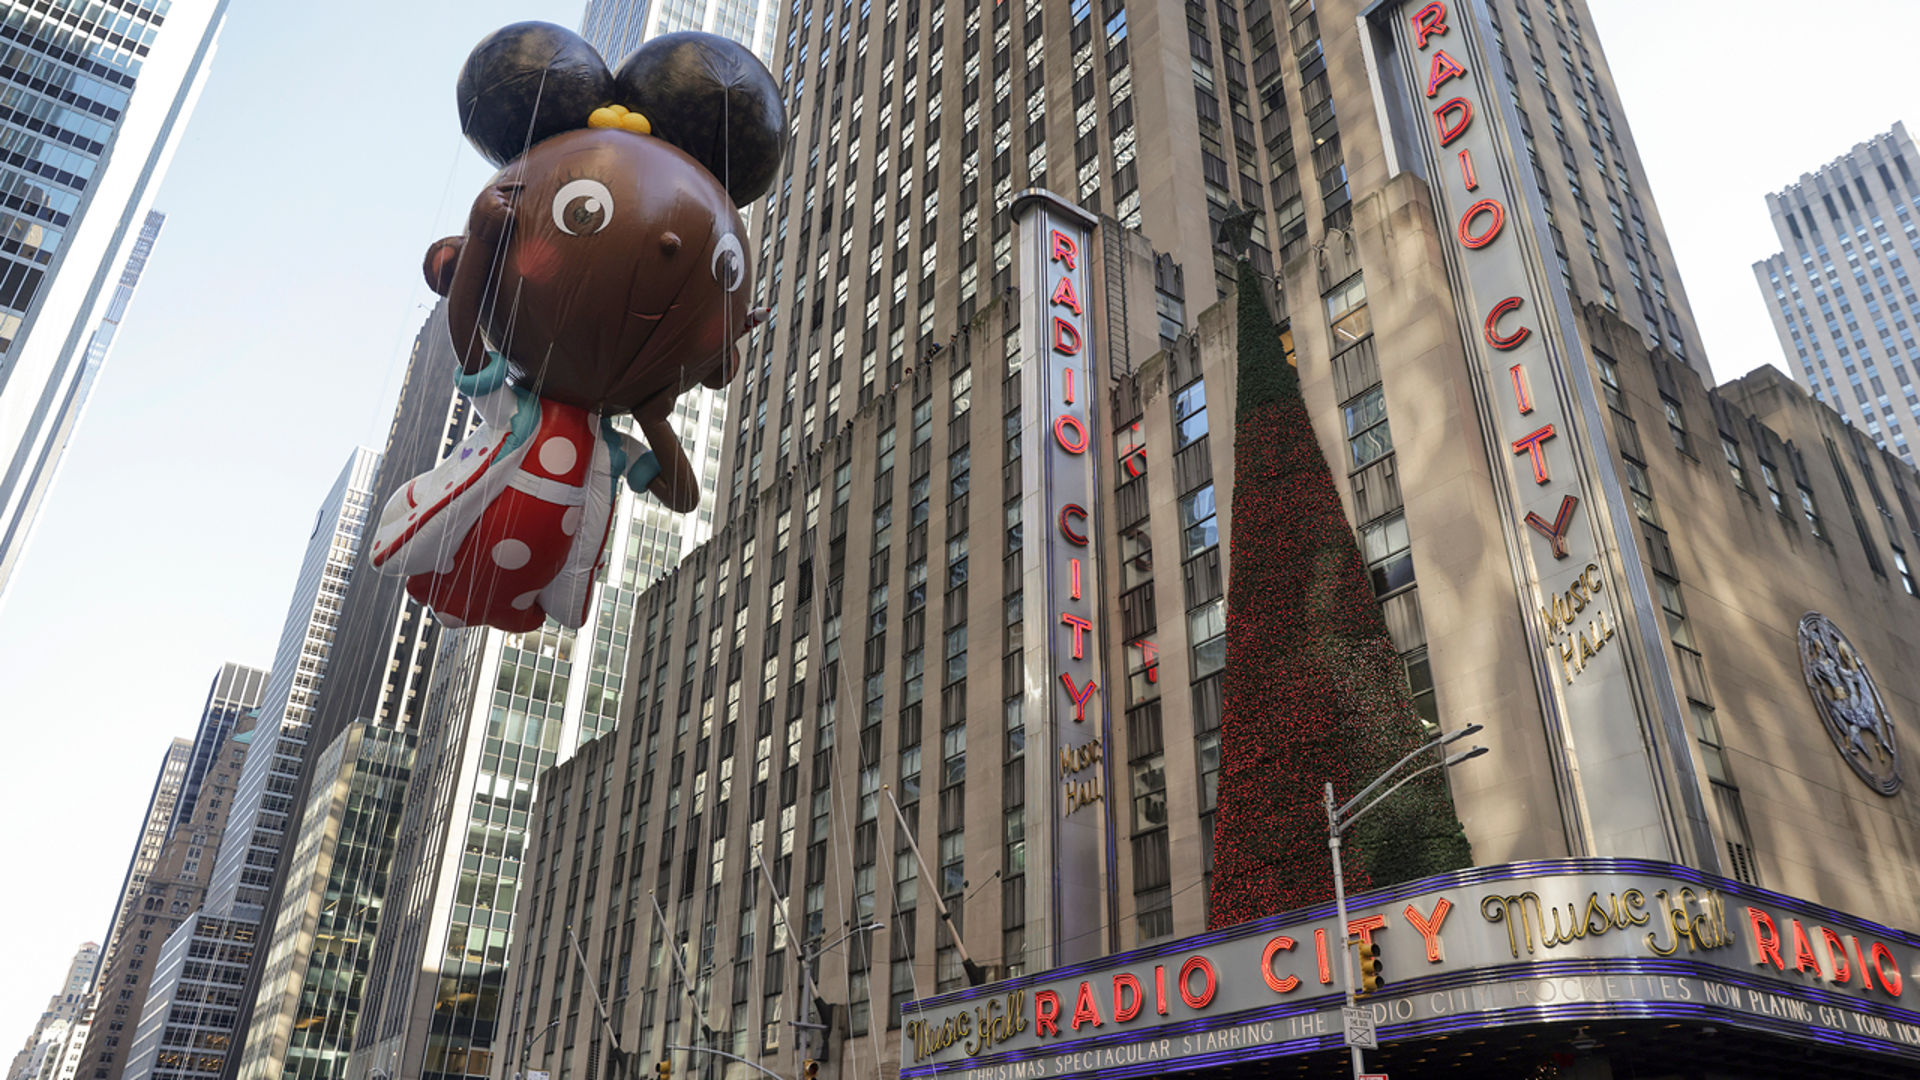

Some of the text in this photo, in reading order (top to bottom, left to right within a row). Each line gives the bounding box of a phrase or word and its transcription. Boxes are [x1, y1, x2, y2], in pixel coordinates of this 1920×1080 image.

[1411, 1, 1579, 560] RADIO CITY
[1051, 229, 1097, 722] RADIO CITY
[906, 886, 1903, 1063] Music Hall RADIO CITY Music Hall RADIO
[1055, 1039, 1171, 1074] SPECTACULAR
[1183, 1021, 1274, 1054] STARRING
[1289, 1012, 1327, 1037] THE
[1361, 998, 1413, 1025] DIO
[1430, 985, 1489, 1014] CITY
[1514, 975, 1692, 1003] ROCKETTES
[1703, 980, 1742, 1009] NOW
[1748, 989, 1813, 1022] PLAYING
[1819, 1005, 1848, 1029] GET
[1852, 1012, 1891, 1038] YOUR
